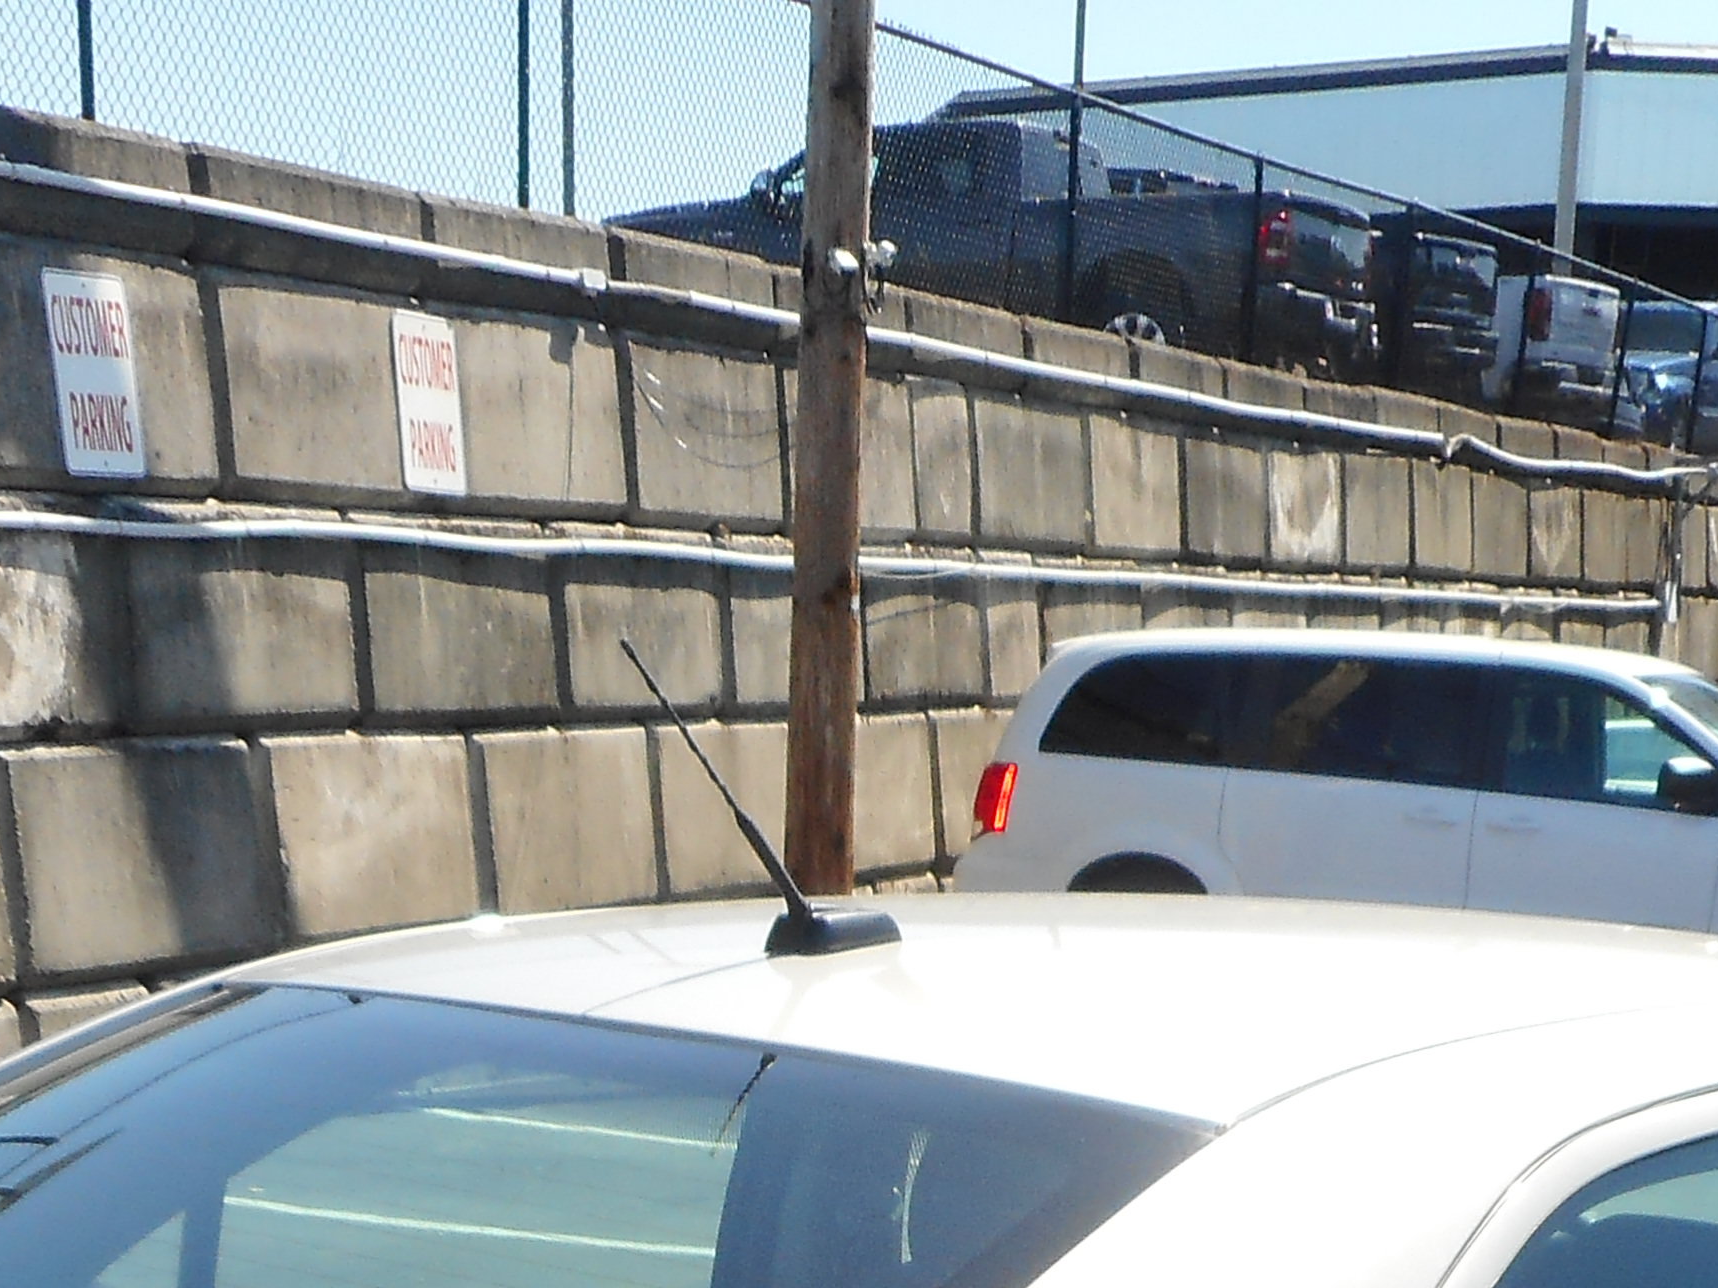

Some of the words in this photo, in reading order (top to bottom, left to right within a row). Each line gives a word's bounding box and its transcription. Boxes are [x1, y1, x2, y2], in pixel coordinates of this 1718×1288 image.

[51, 294, 130, 360] CUSTOMER
[399, 333, 455, 391] CUSTOMER
[70, 391, 133, 453] PARKING
[410, 418, 456, 473] PARKING
